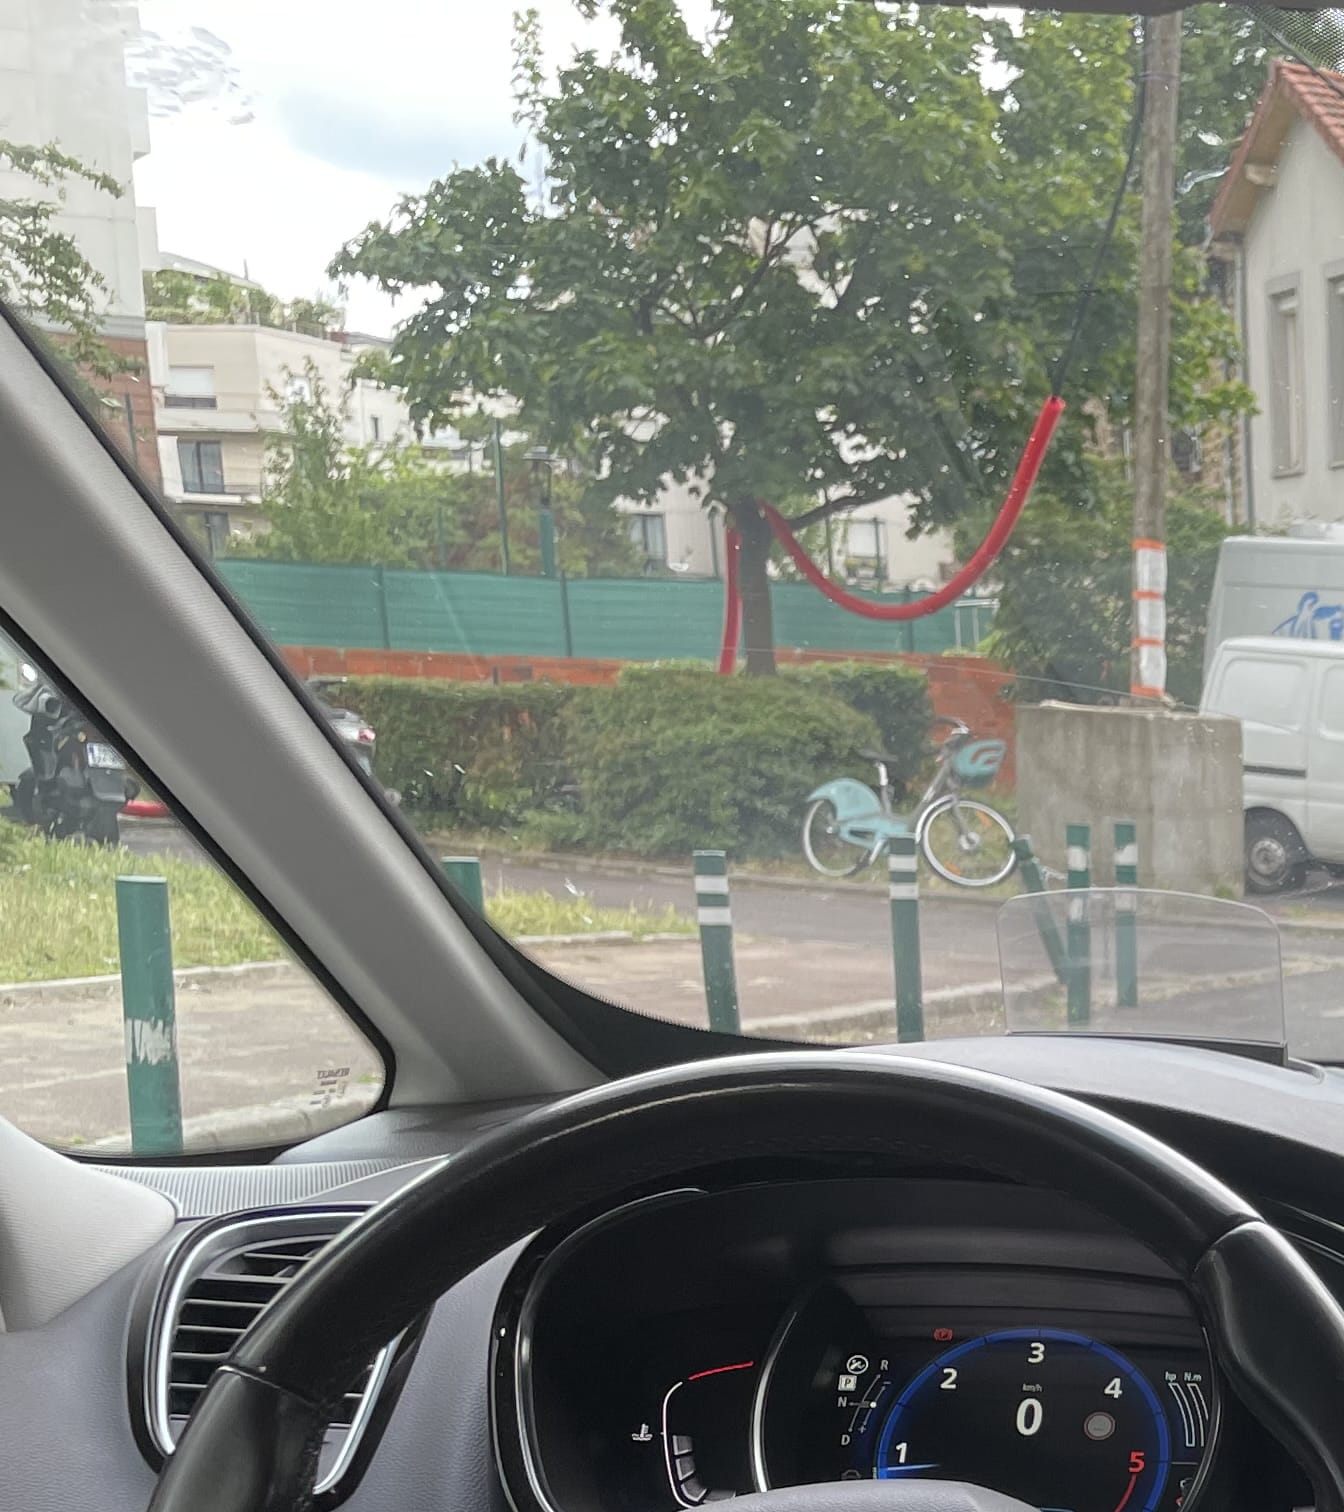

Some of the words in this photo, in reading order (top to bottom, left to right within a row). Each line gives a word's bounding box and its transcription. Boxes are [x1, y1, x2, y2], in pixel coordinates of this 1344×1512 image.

[1028, 1342, 1046, 1364] 3
[880, 1359, 889, 1371] R
[940, 1369, 958, 1390] 2
[1103, 1378, 1124, 1399] 4
[837, 1396, 848, 1408] N
[1015, 1397, 1043, 1437] 0
[841, 1434, 851, 1446] D
[895, 1441, 908, 1464] 1
[1128, 1451, 1146, 1473] 5
